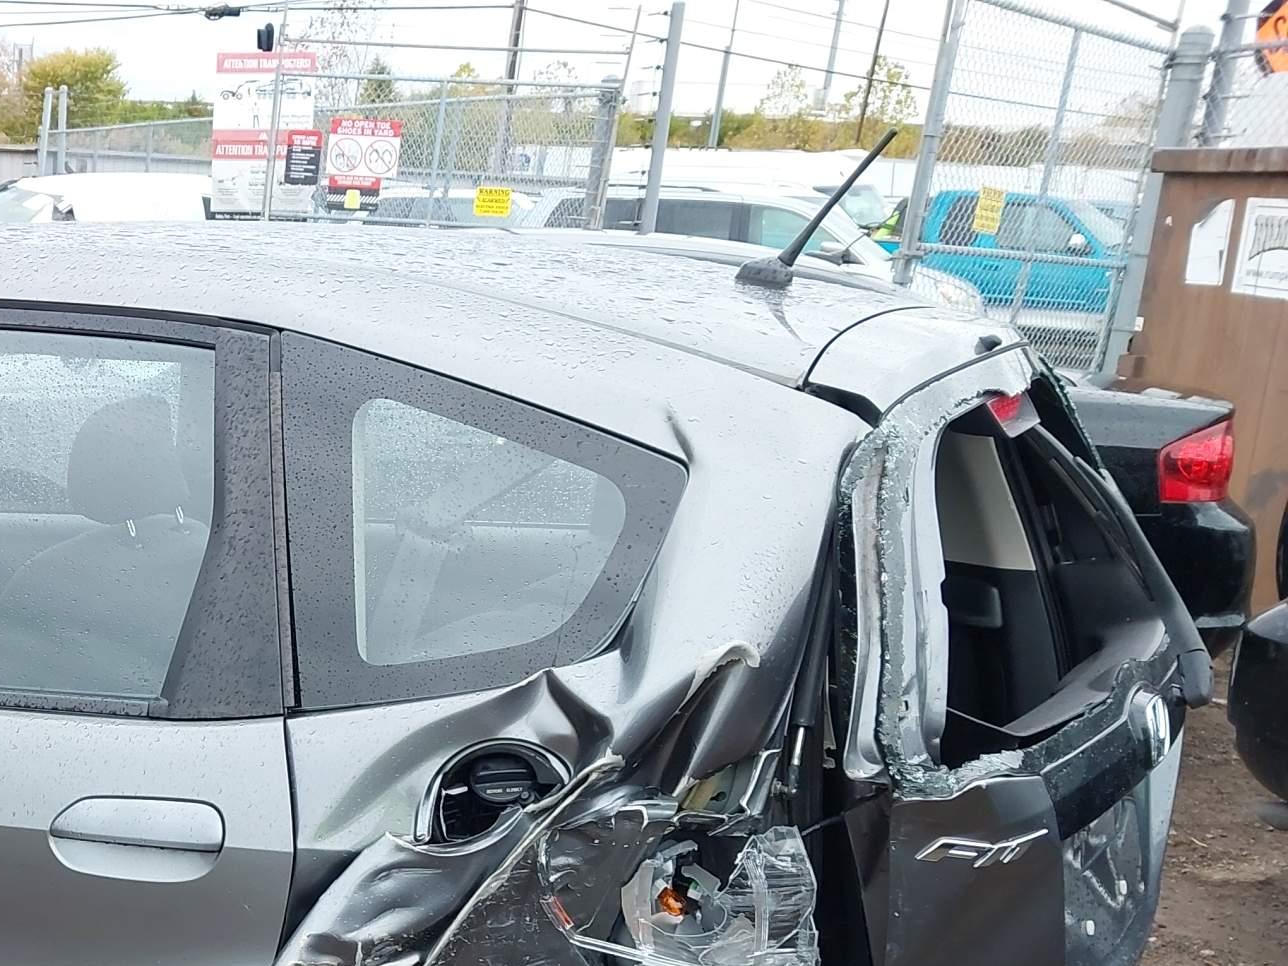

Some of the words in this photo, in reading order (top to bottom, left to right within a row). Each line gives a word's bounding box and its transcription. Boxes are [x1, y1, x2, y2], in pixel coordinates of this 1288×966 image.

[341, 119, 353, 127] NO
[354, 120, 375, 128] OPEN
[376, 121, 391, 129] TOE
[337, 126, 362, 135] SHOES
[374, 129, 394, 137] YARD
[215, 144, 253, 155] ATTENTION
